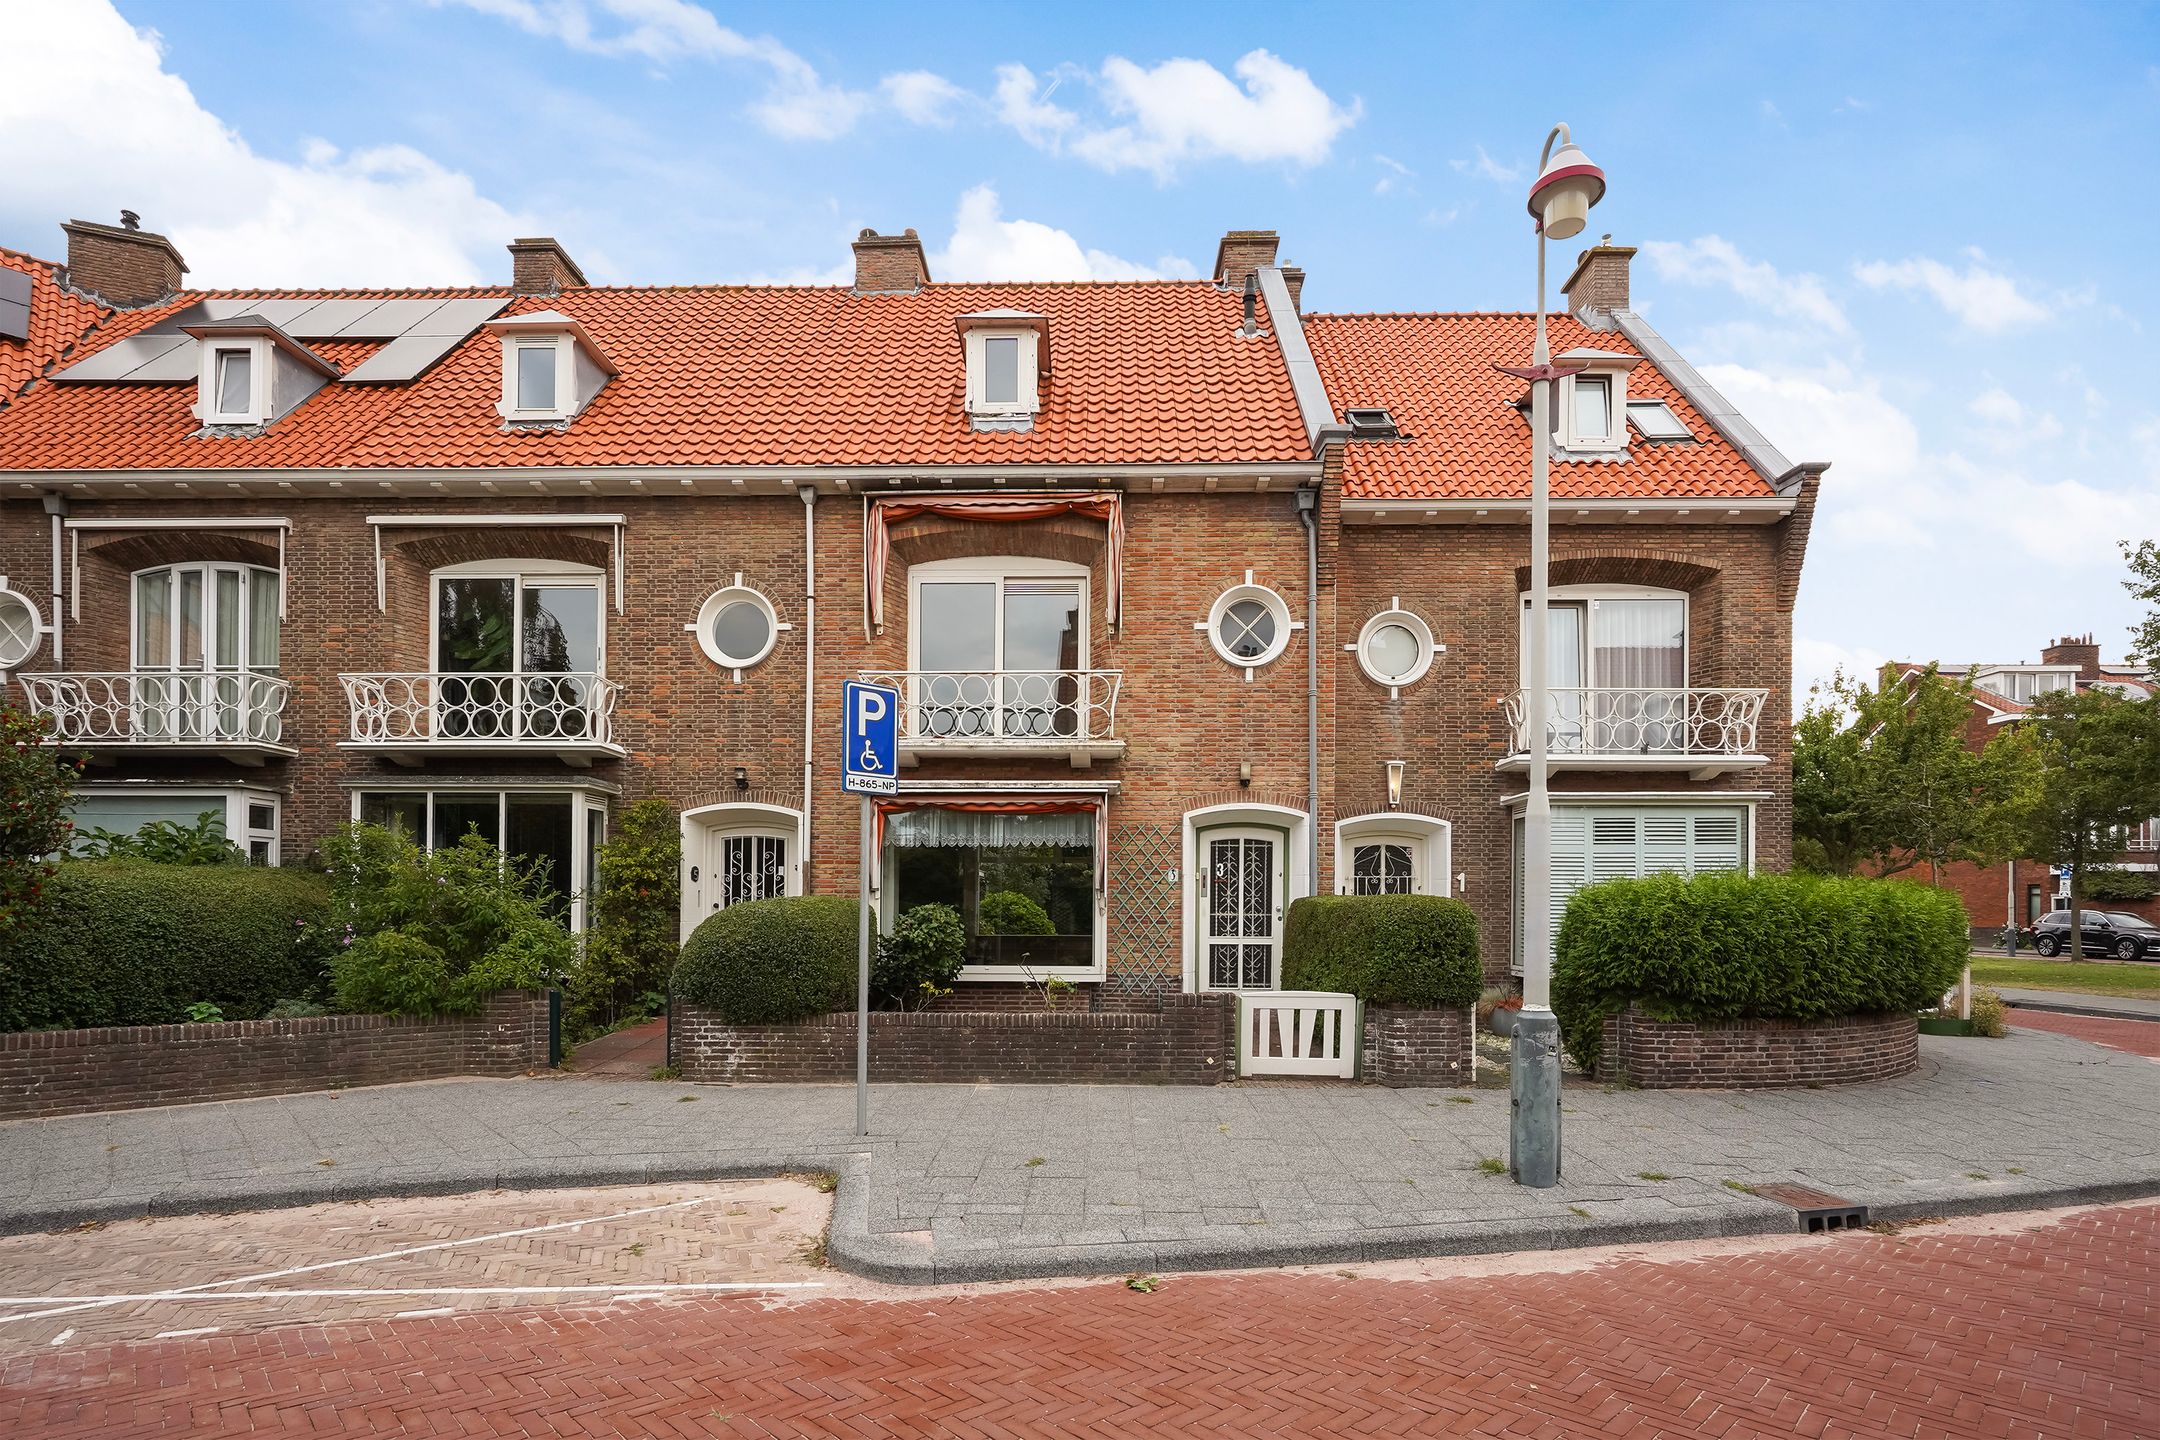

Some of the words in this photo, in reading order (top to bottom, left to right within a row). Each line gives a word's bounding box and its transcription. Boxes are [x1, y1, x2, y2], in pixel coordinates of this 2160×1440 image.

[858, 690, 886, 736] P
[848, 777, 895, 791] H-865-NP
[1216, 863, 1224, 877] 3
[1456, 872, 1465, 892] 1
